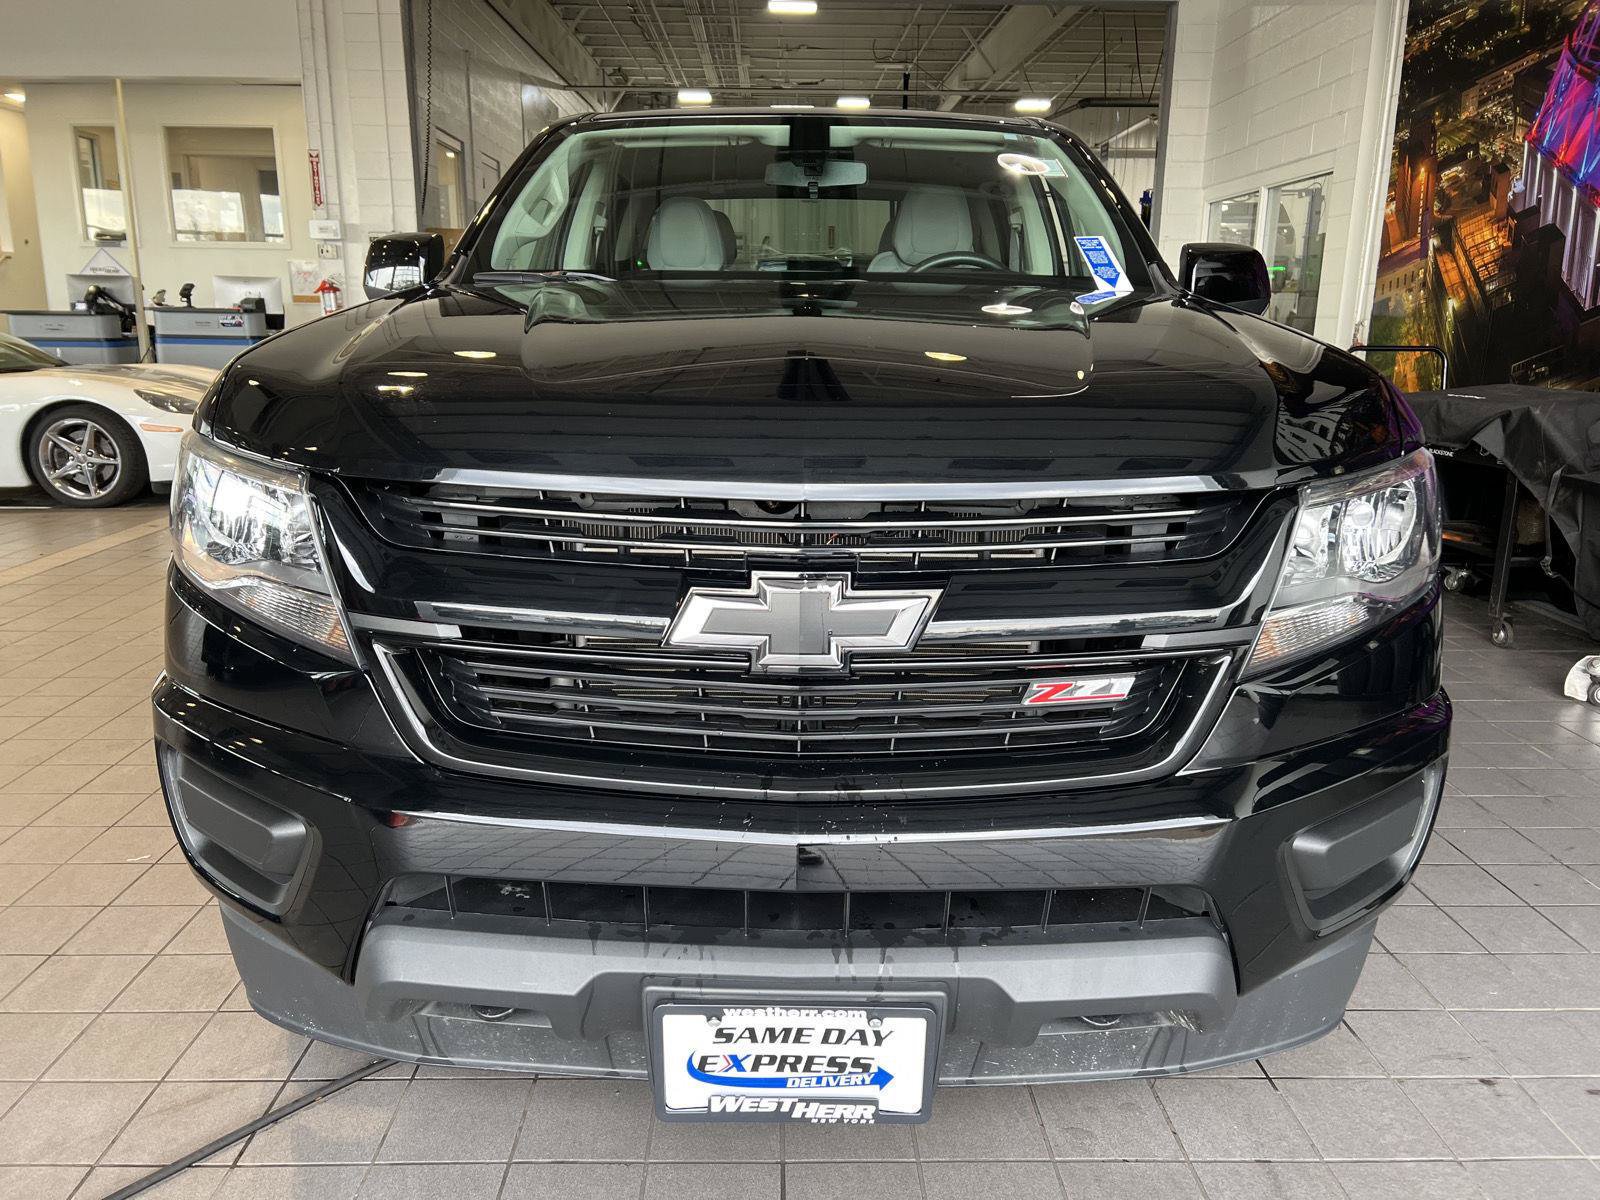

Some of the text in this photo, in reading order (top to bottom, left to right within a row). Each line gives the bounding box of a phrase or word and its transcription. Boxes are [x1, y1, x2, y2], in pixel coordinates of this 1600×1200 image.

[1023, 677, 1136, 705] Z71
[722, 1007, 868, 1020] westherr.com
[712, 1027, 895, 1047] SAME DAY
[697, 1054, 875, 1074] EXPRESS
[786, 1073, 876, 1088] DELIVERY
